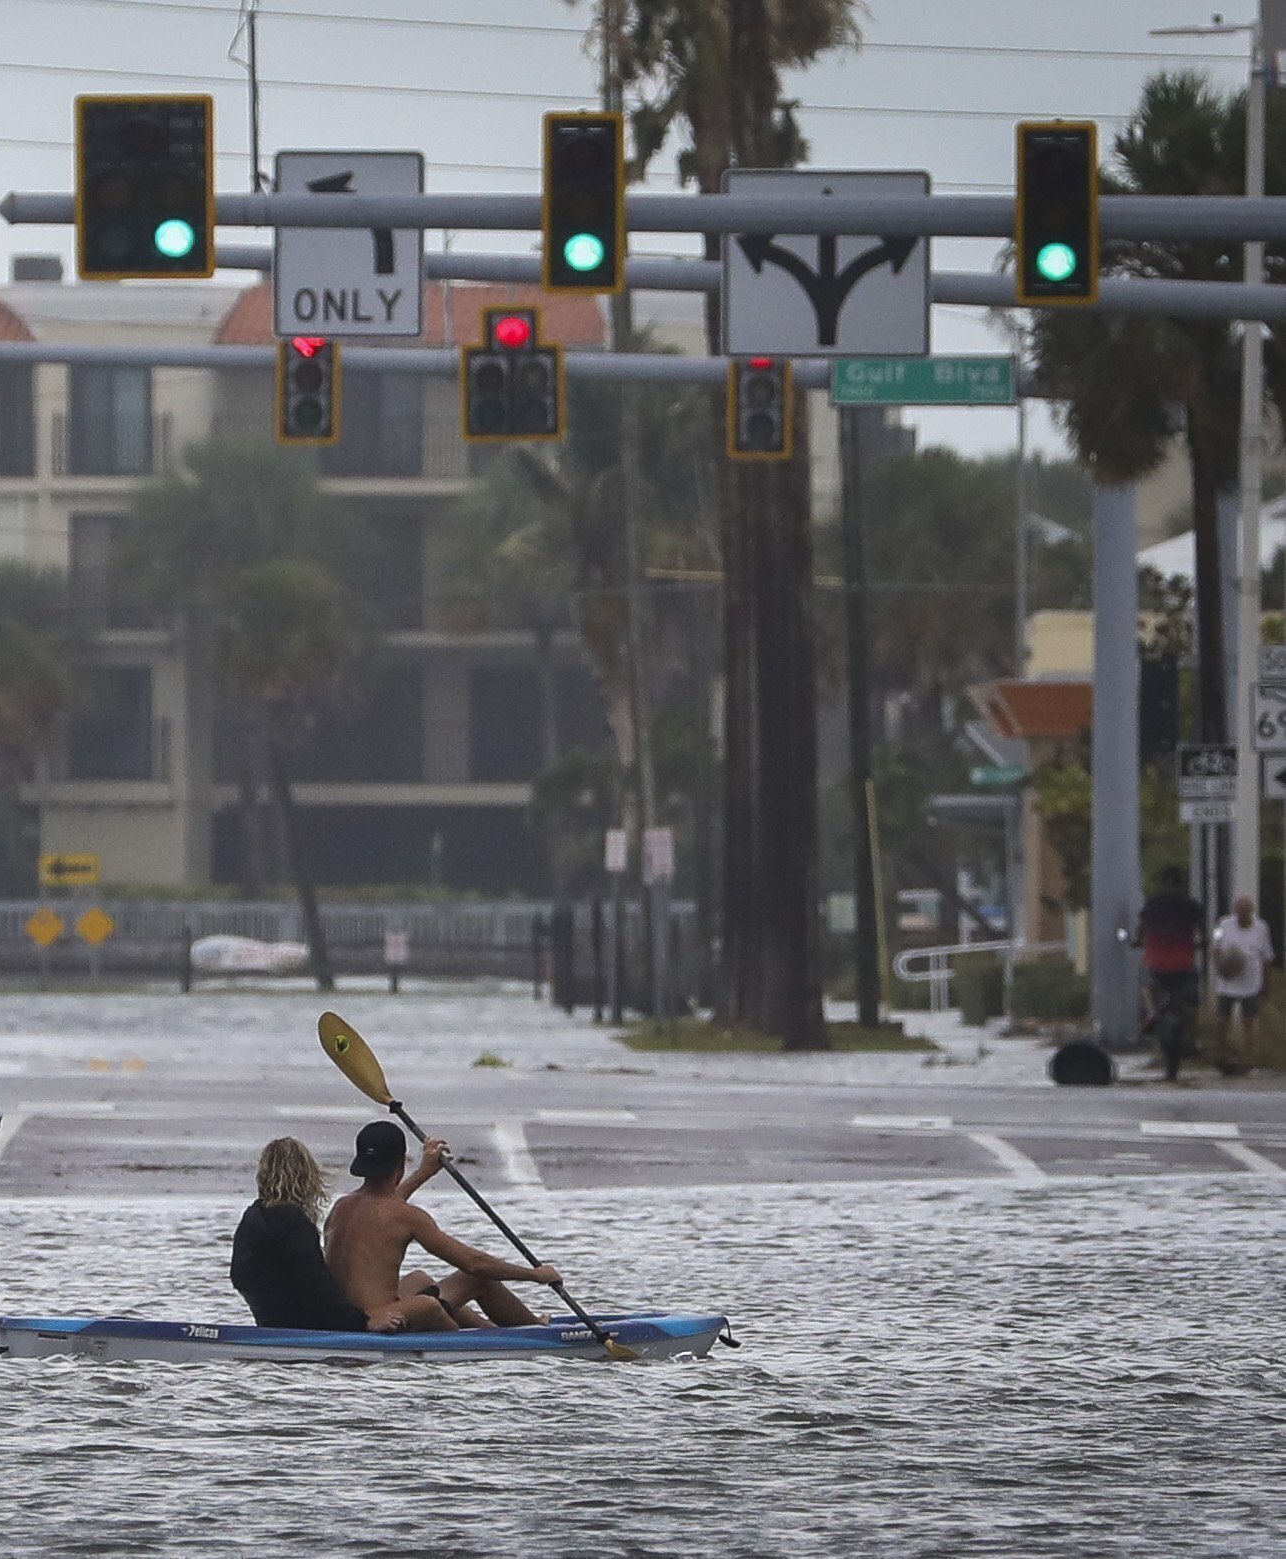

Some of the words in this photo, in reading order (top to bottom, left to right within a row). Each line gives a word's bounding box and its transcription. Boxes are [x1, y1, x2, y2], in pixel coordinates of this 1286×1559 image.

[293, 287, 402, 322] ONLY
[846, 362, 906, 384] Gulf
[933, 362, 1000, 384] Blvd
[188, 1324, 219, 1339] Pelican
